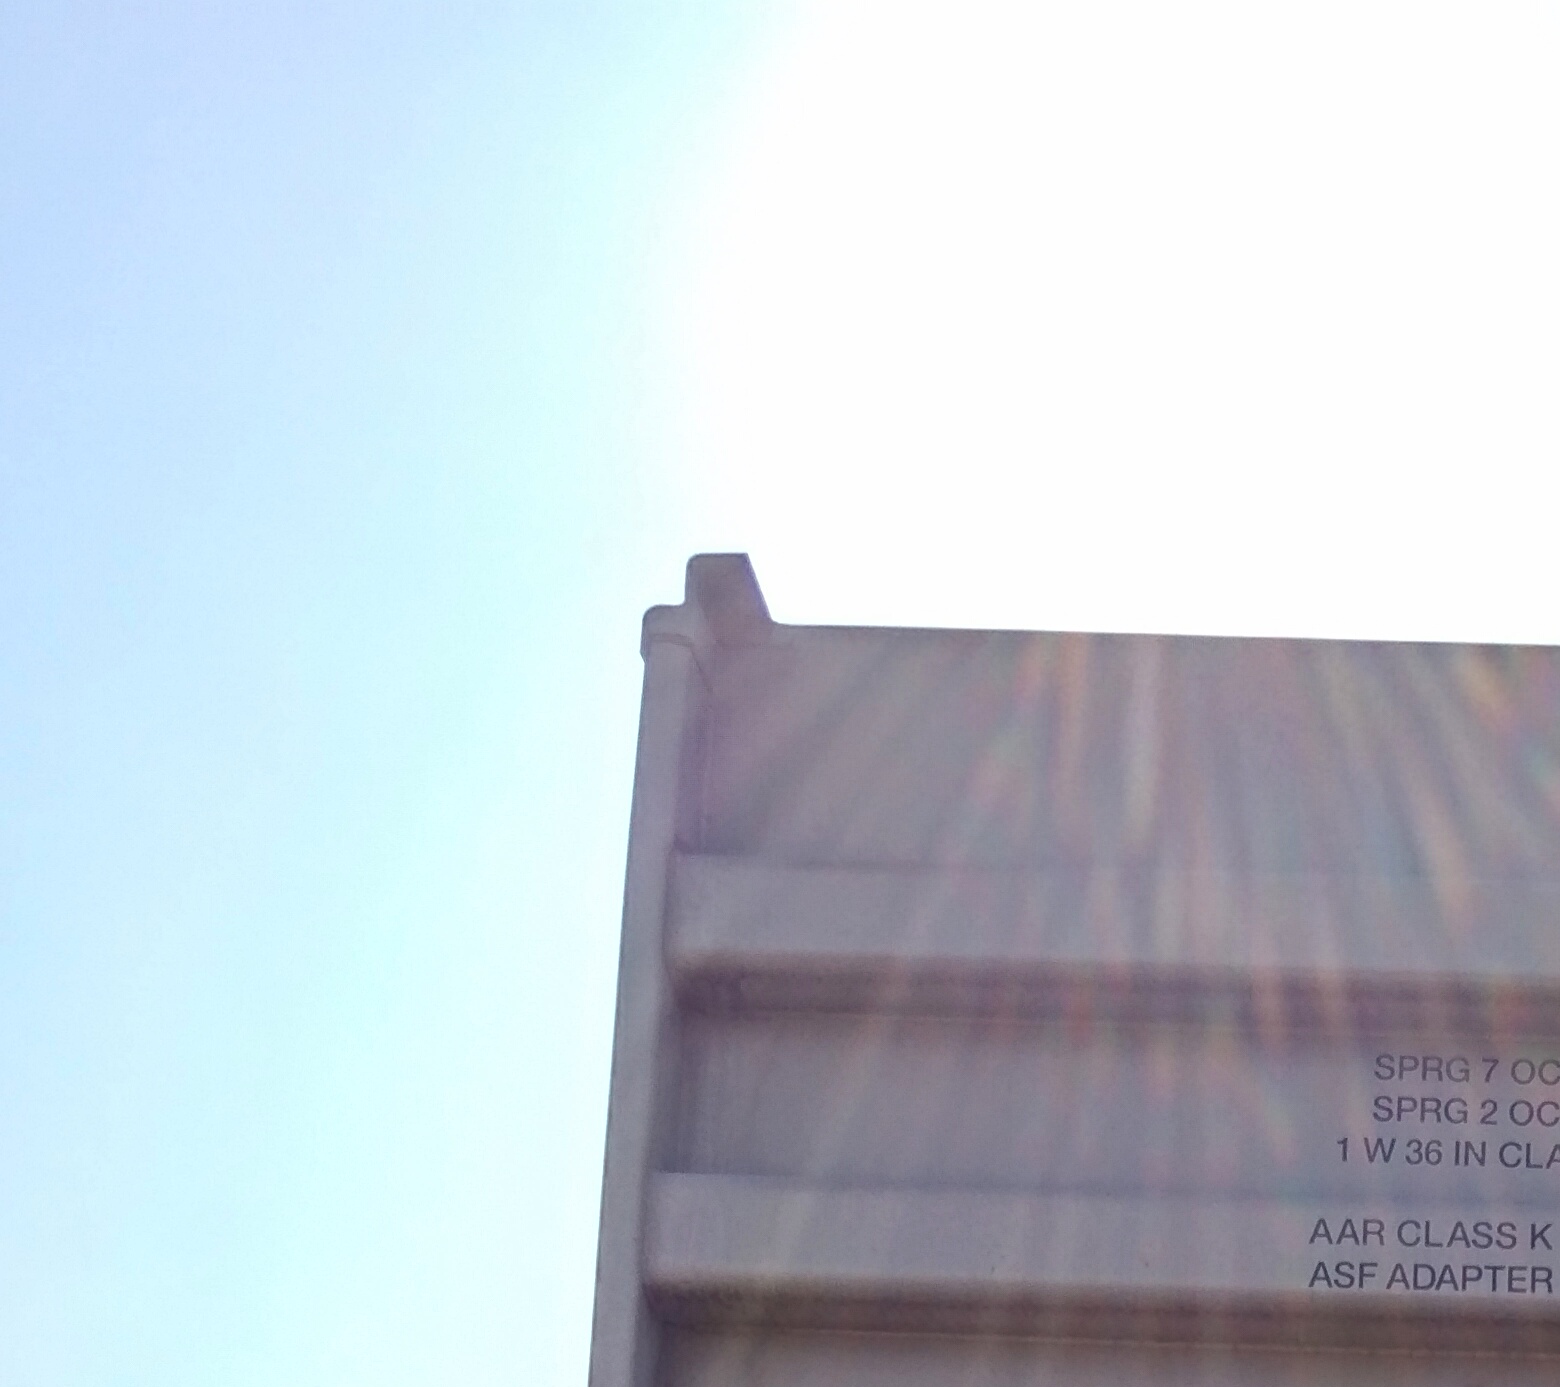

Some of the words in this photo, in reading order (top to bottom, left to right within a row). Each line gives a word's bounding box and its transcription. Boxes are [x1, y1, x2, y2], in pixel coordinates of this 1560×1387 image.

[1373, 1054, 1470, 1083] SPRG
[1481, 1058, 1500, 1083] 7
[1372, 1096, 1468, 1125] SPRG
[1479, 1100, 1498, 1126] 2
[1508, 1100, 1560, 1127] OC
[1336, 1138, 1349, 1162] 1
[1363, 1138, 1397, 1164] W
[1405, 1139, 1443, 1166] 36
[1454, 1141, 1487, 1167] IN
[1308, 1218, 1385, 1246] AAR
[1397, 1220, 1517, 1250] CLASS
[1530, 1224, 1553, 1251] K
[1308, 1262, 1378, 1289] ASF
[1386, 1264, 1553, 1293] ADAPTER
